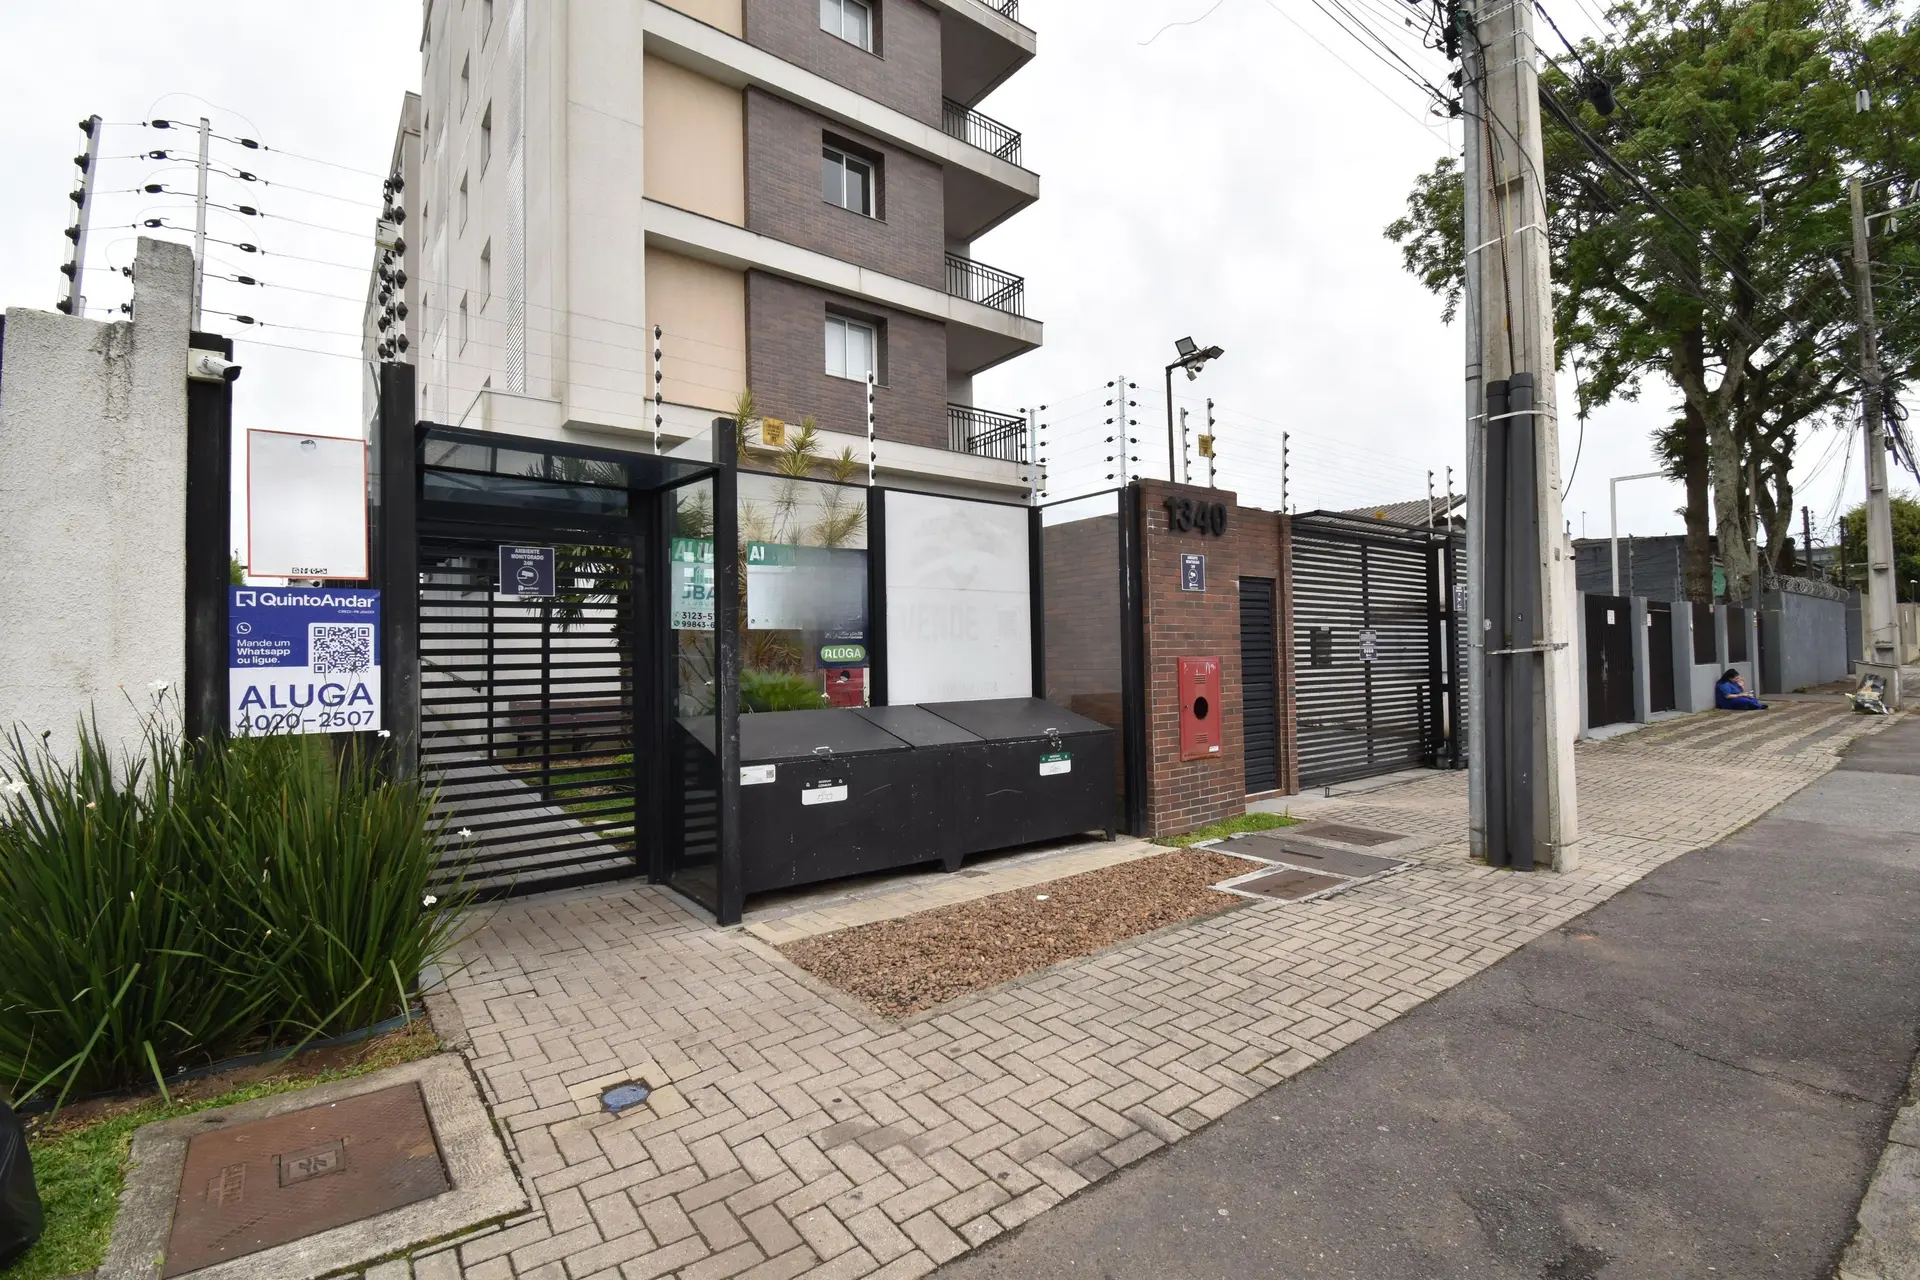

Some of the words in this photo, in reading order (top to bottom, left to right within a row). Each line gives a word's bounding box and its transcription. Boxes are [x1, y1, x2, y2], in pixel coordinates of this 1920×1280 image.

[1164, 496, 1227, 536] 1340
[259, 592, 375, 608] QuintoAndar
[236, 639, 272, 647] Mande
[236, 647, 290, 656] Whatsapp
[252, 655, 280, 666] ligue.
[238, 682, 374, 711] ALUGA
[237, 710, 375, 731] 4020-2507
